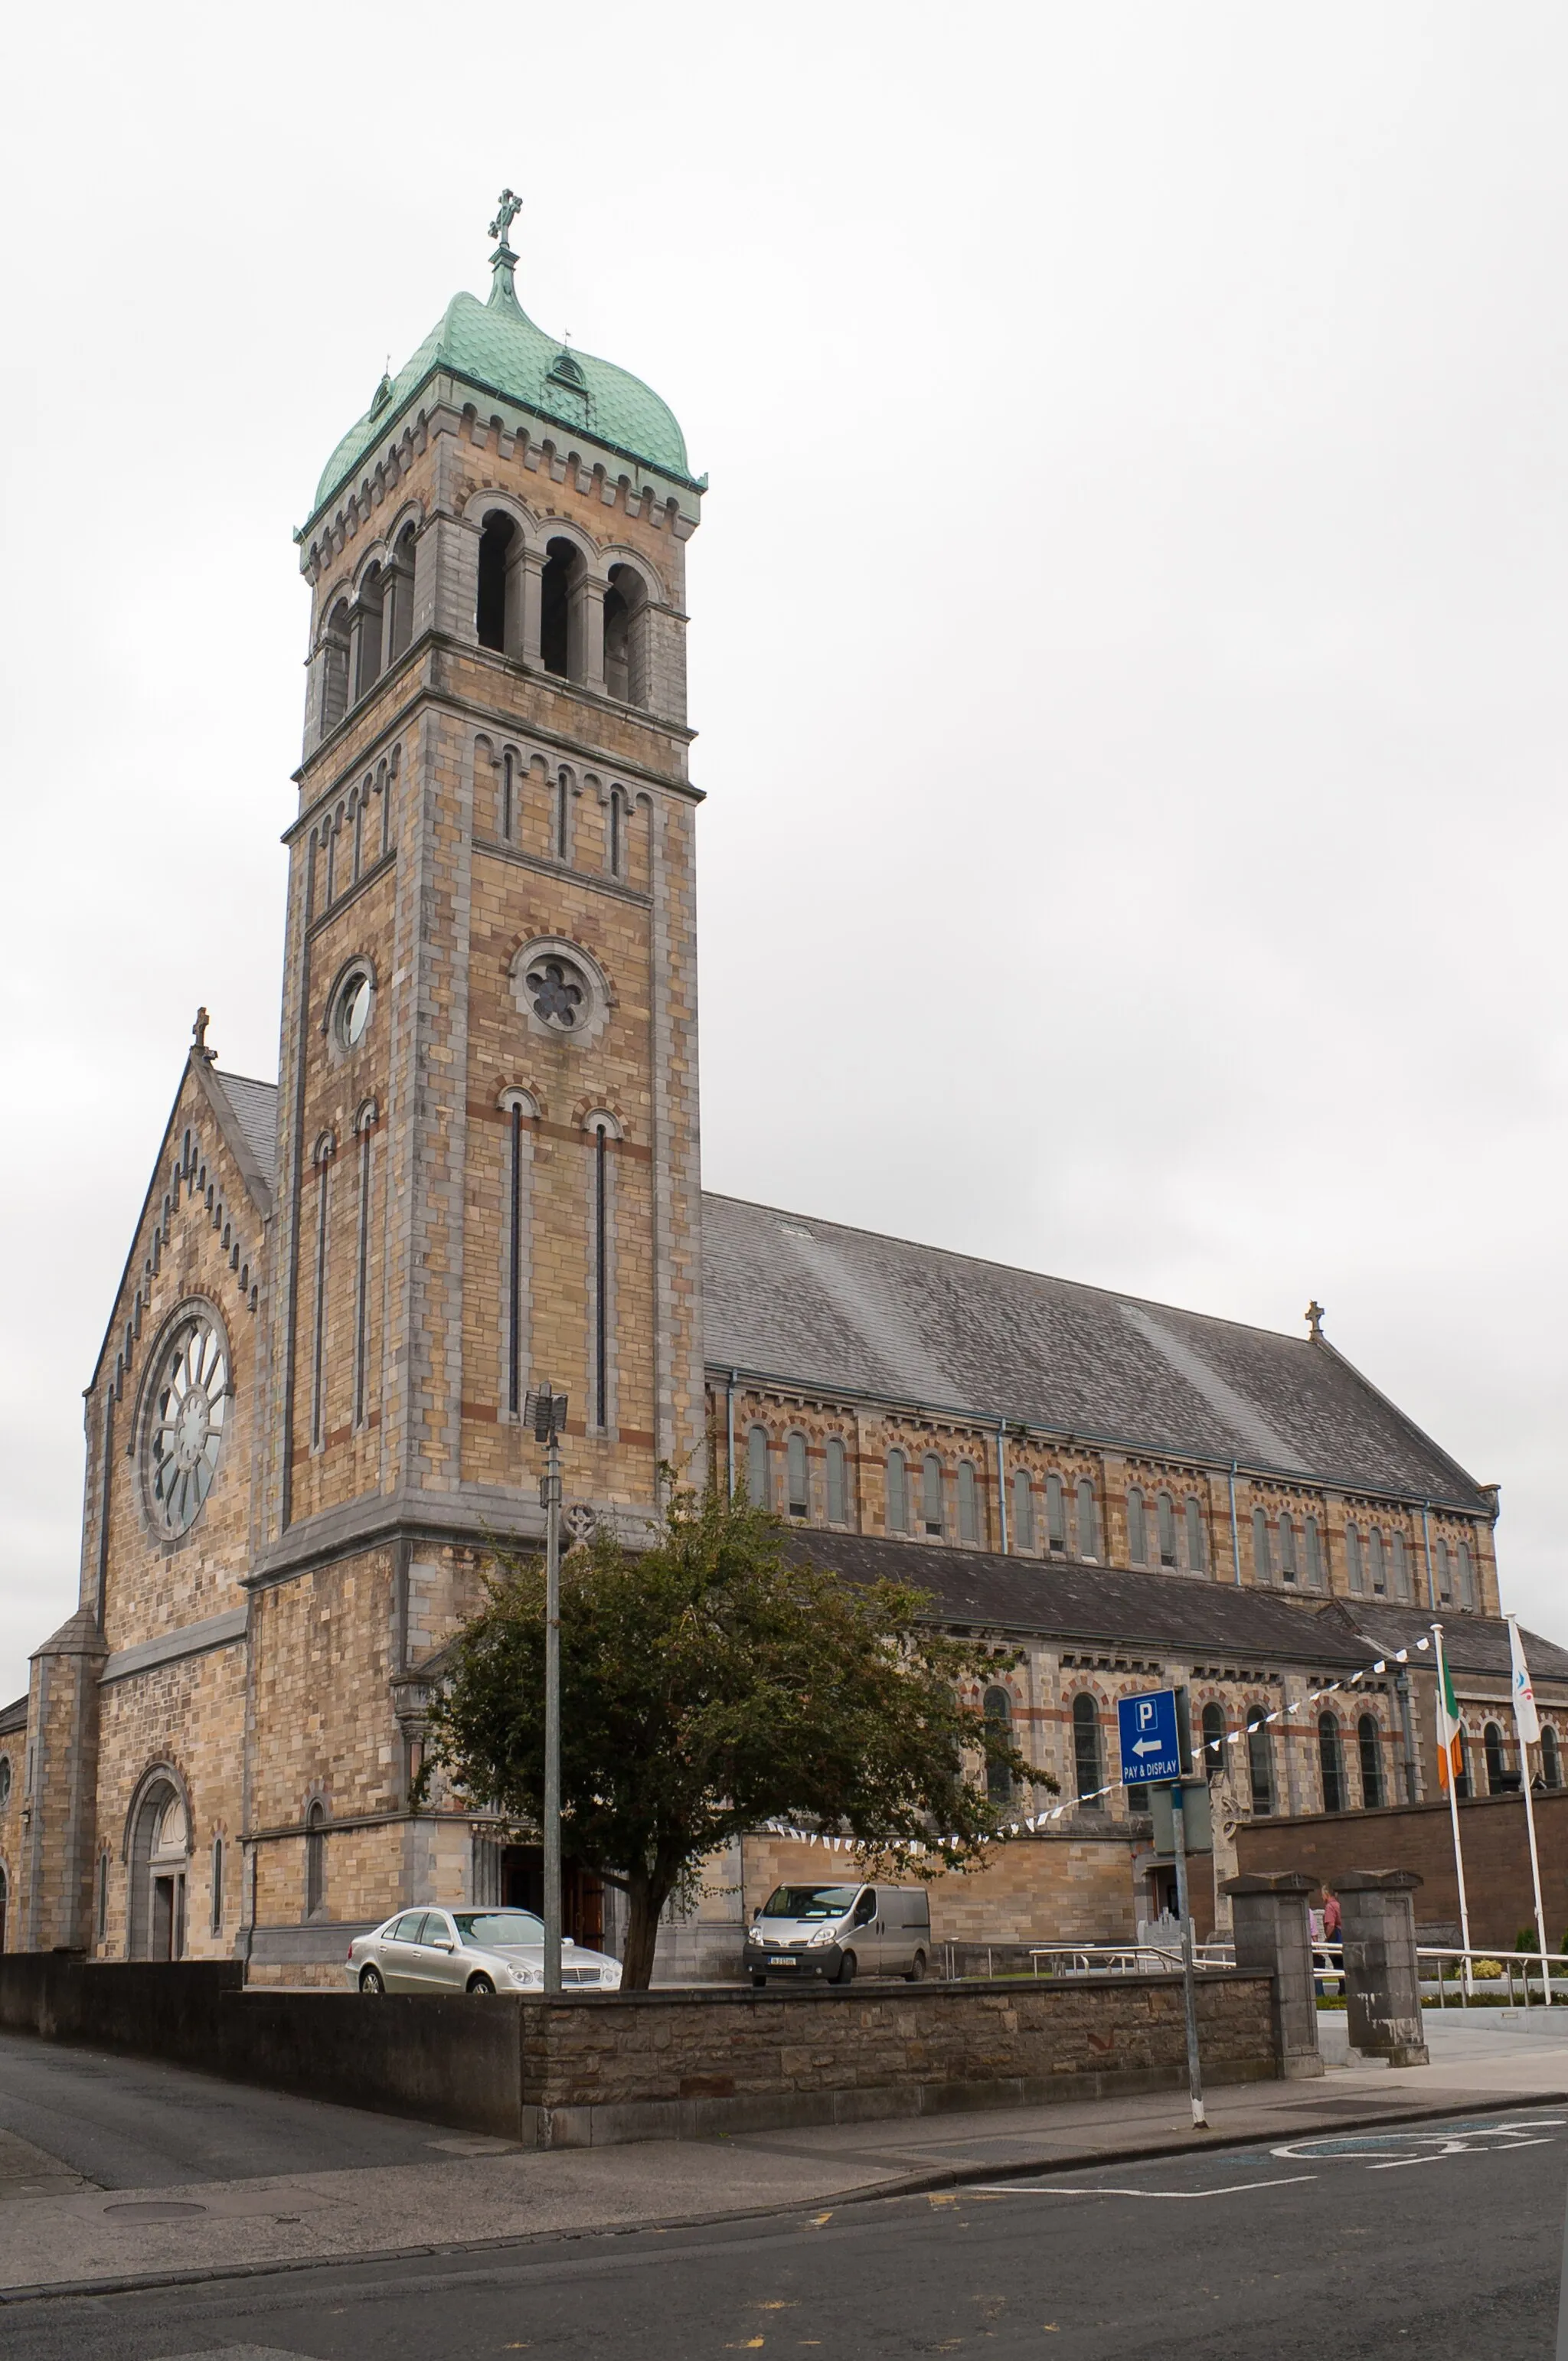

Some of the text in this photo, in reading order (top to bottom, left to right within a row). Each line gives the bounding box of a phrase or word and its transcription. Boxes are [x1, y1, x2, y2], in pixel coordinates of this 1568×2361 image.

[1139, 1703, 1152, 1729] P
[1124, 1759, 1177, 1779] PAY & DISPLAY
